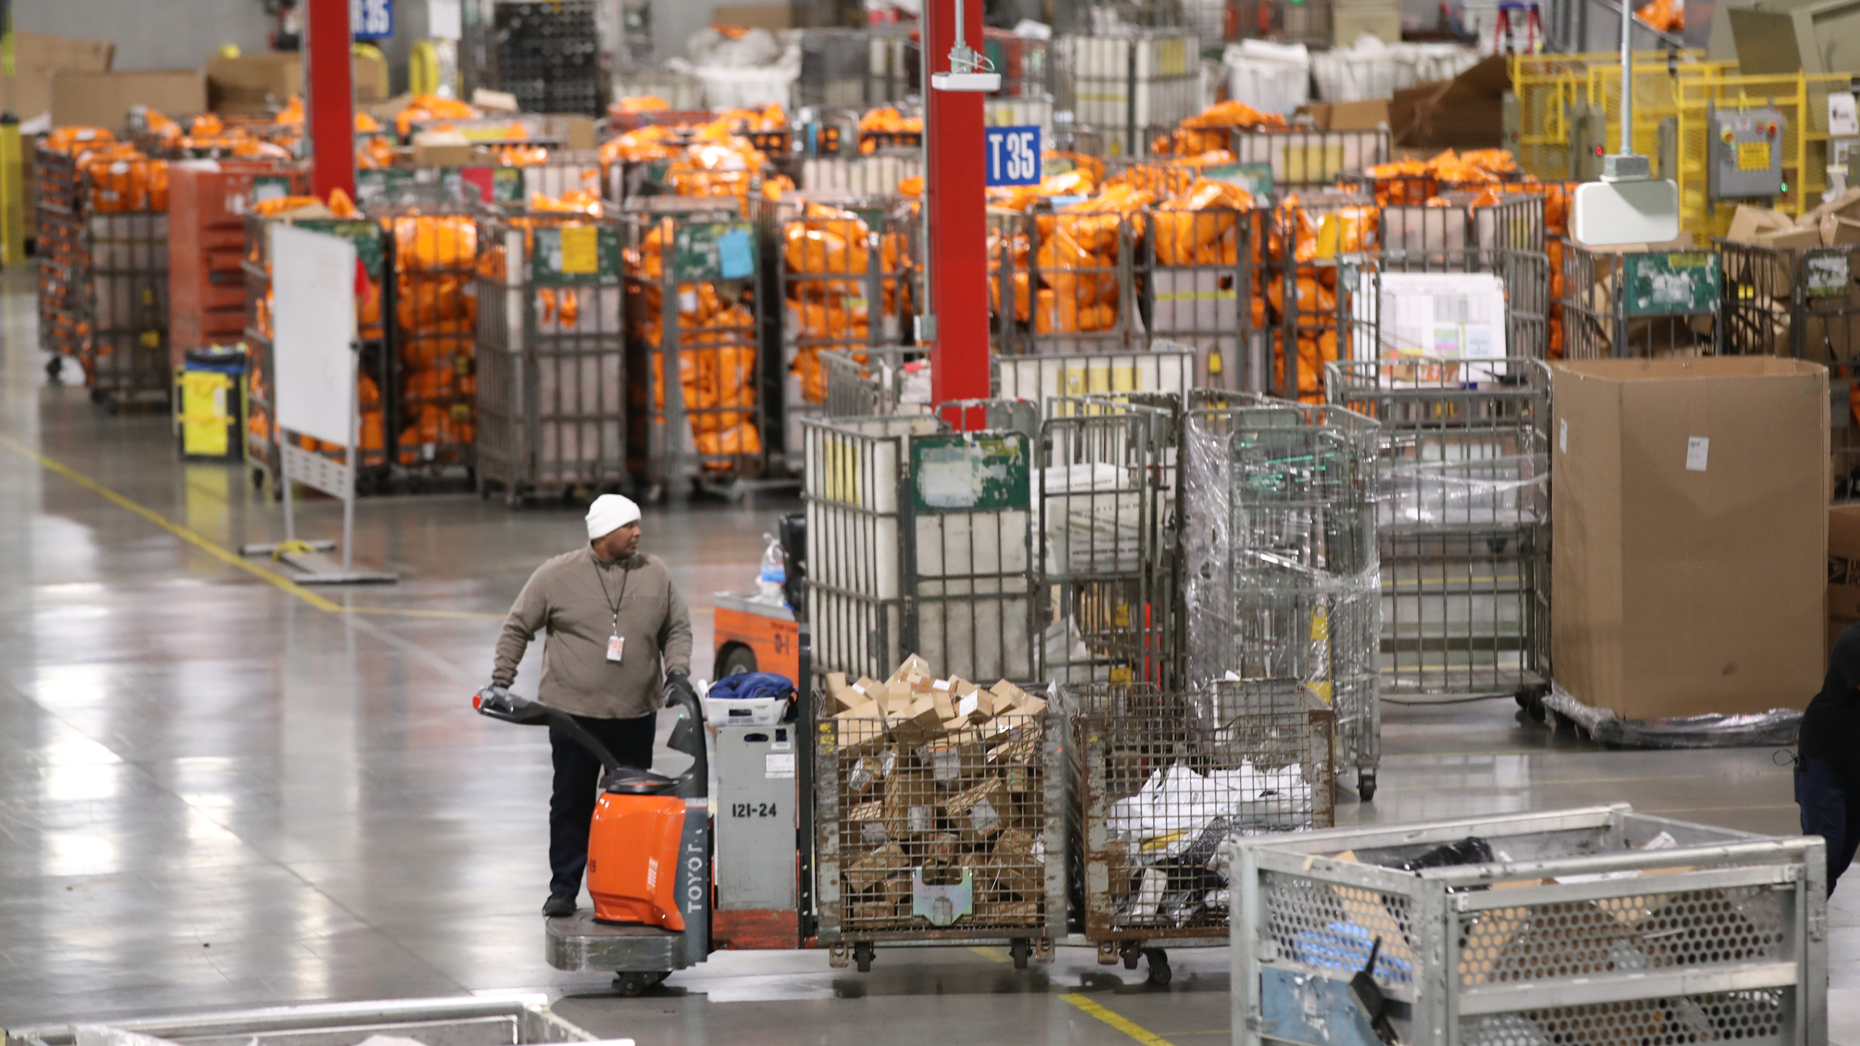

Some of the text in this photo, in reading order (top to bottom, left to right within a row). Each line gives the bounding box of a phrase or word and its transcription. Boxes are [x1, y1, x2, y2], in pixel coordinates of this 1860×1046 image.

[988, 131, 1035, 180] T 35
[732, 802, 777, 818] 121-24
